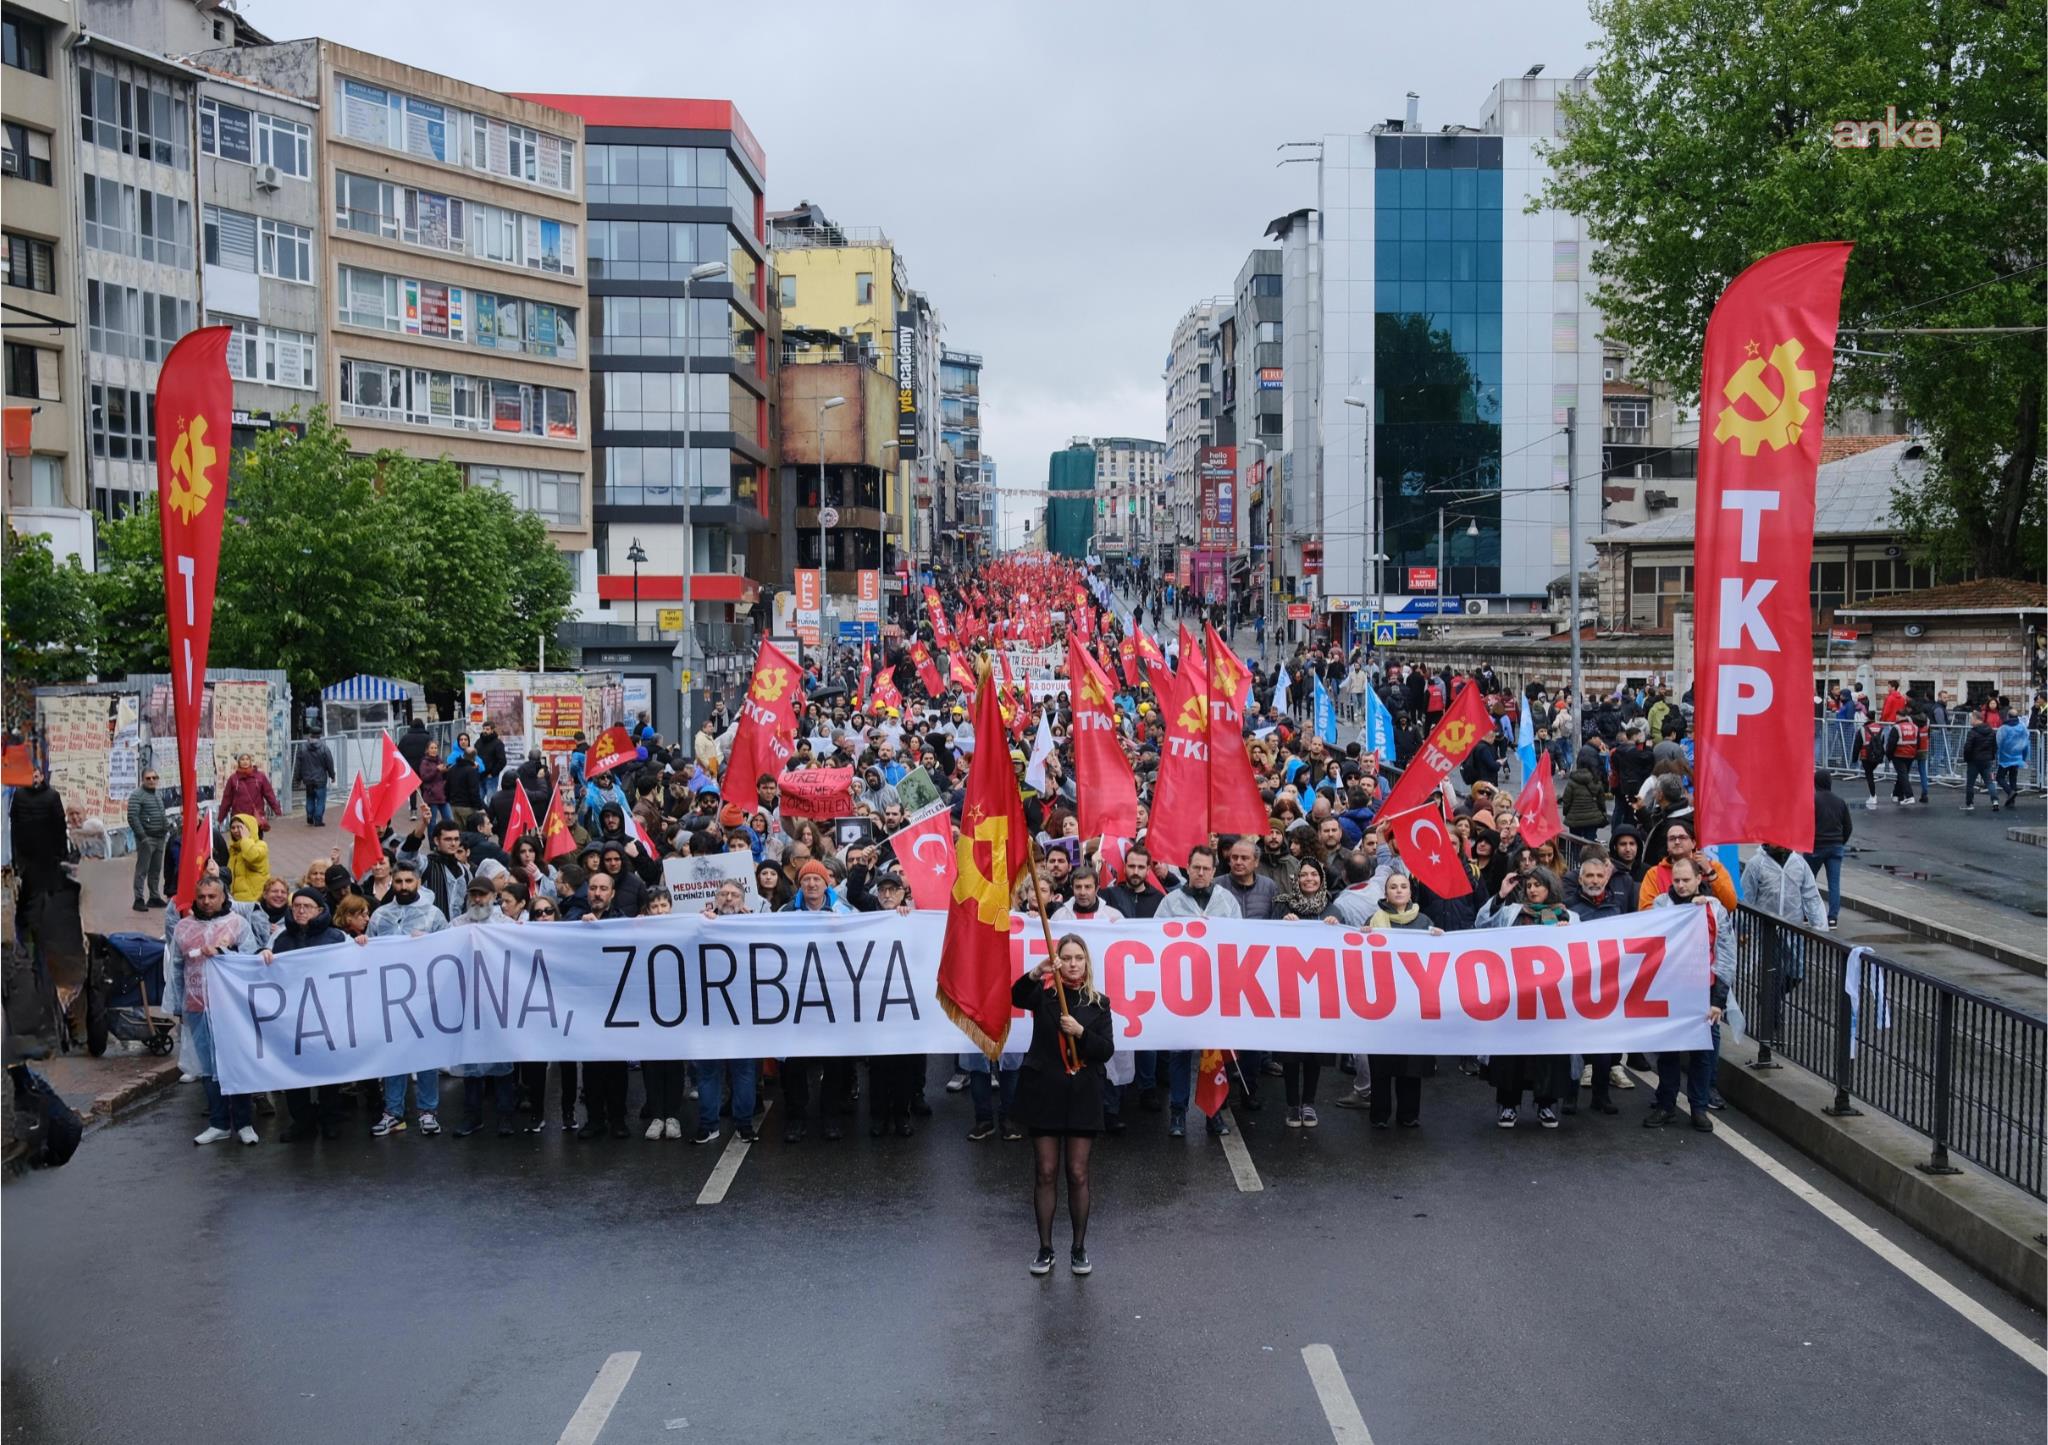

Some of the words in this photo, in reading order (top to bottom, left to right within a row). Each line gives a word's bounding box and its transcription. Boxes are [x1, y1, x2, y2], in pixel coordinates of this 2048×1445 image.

[802, 572, 813, 609] UTTS
[864, 572, 873, 599] UTTS
[1717, 490, 1782, 736] TKP
[744, 700, 776, 726] TKP
[597, 753, 620, 769] TKP
[1423, 744, 1453, 772] TKP
[673, 891, 705, 901] GEMİNİZİ
[248, 949, 574, 1059] PATRONA,
[602, 940, 920, 1028] ZORBAYA
[1103, 920, 1670, 1038] ÇÖKMÜYORUZ
